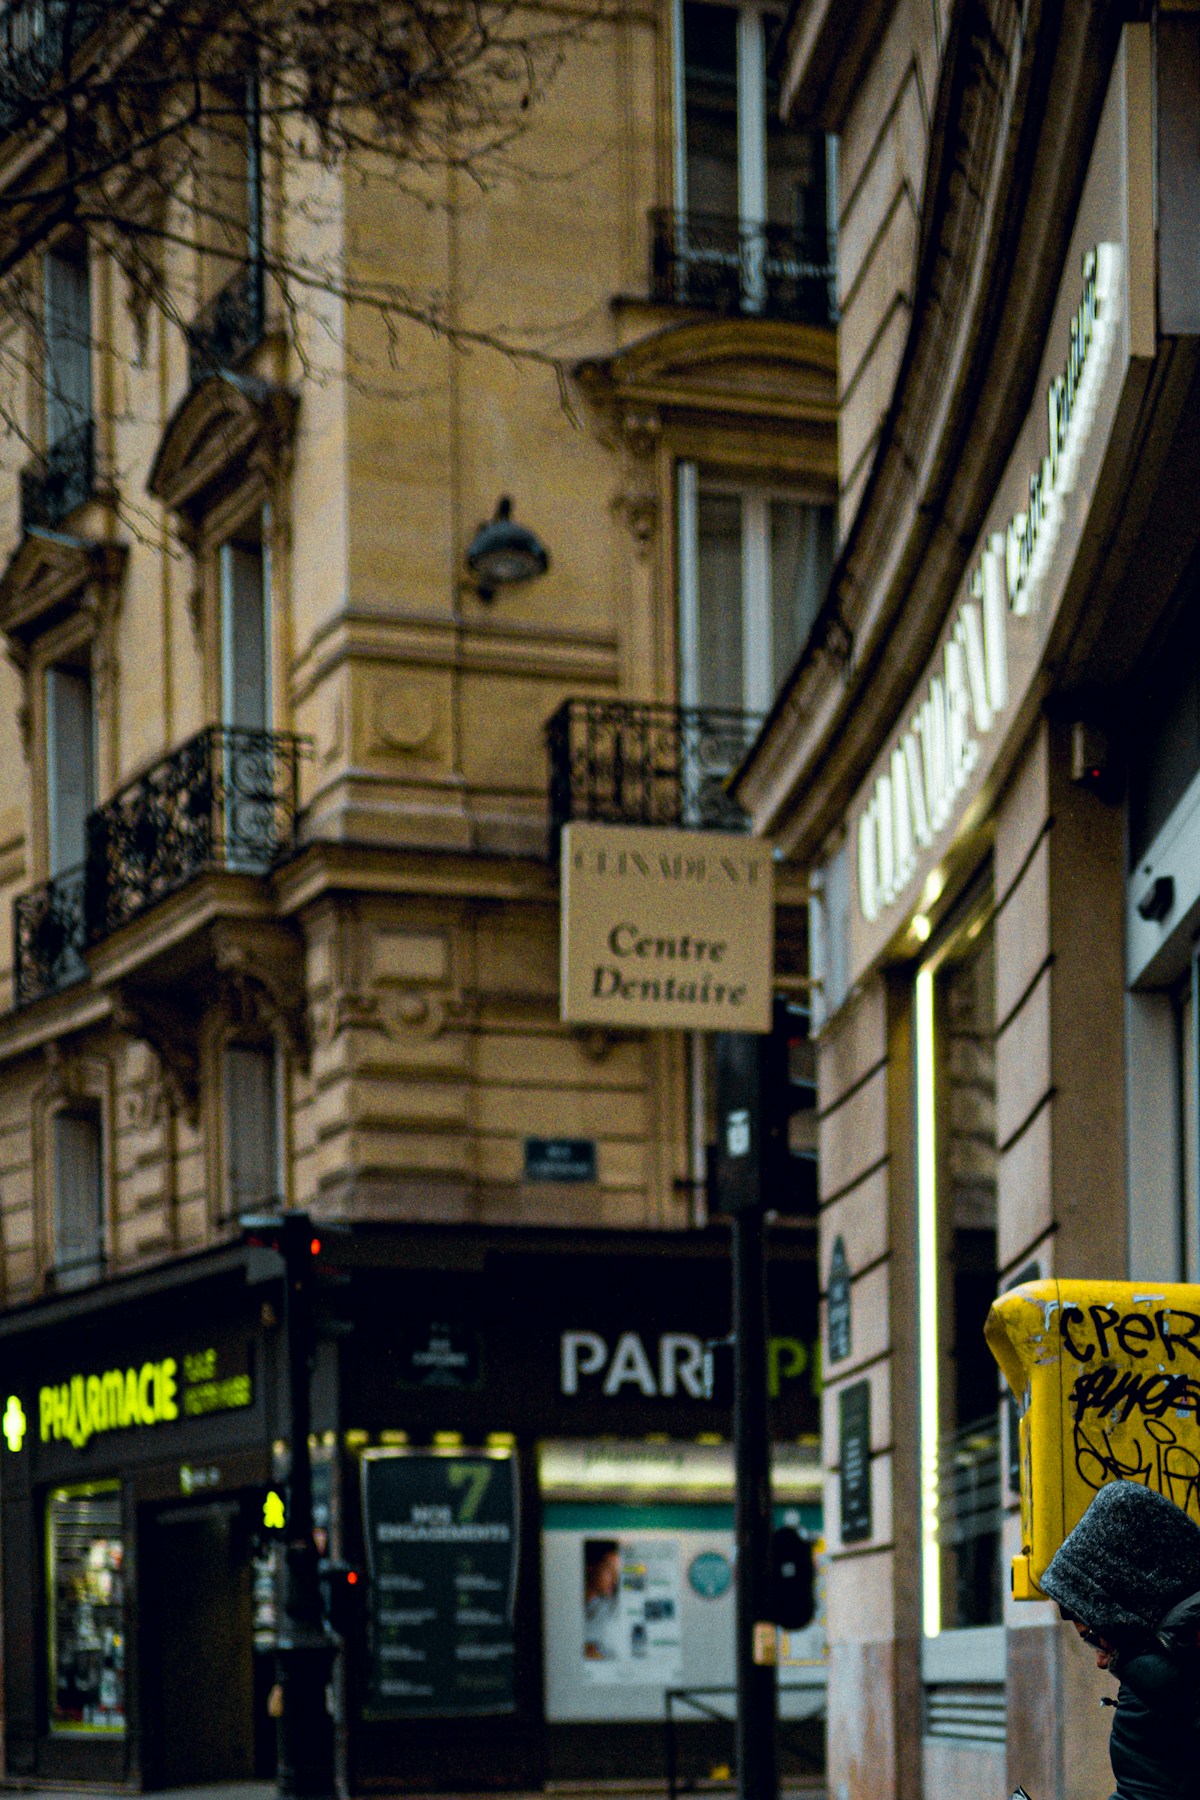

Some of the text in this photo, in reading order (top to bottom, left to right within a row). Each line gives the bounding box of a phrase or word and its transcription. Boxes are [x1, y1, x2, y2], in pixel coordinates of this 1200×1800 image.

[609, 920, 727, 963] Centre
[592, 963, 747, 1006] Dentaire
[39, 1357, 179, 1448] PHARMACIE
[448, 1463, 492, 1524] 7
